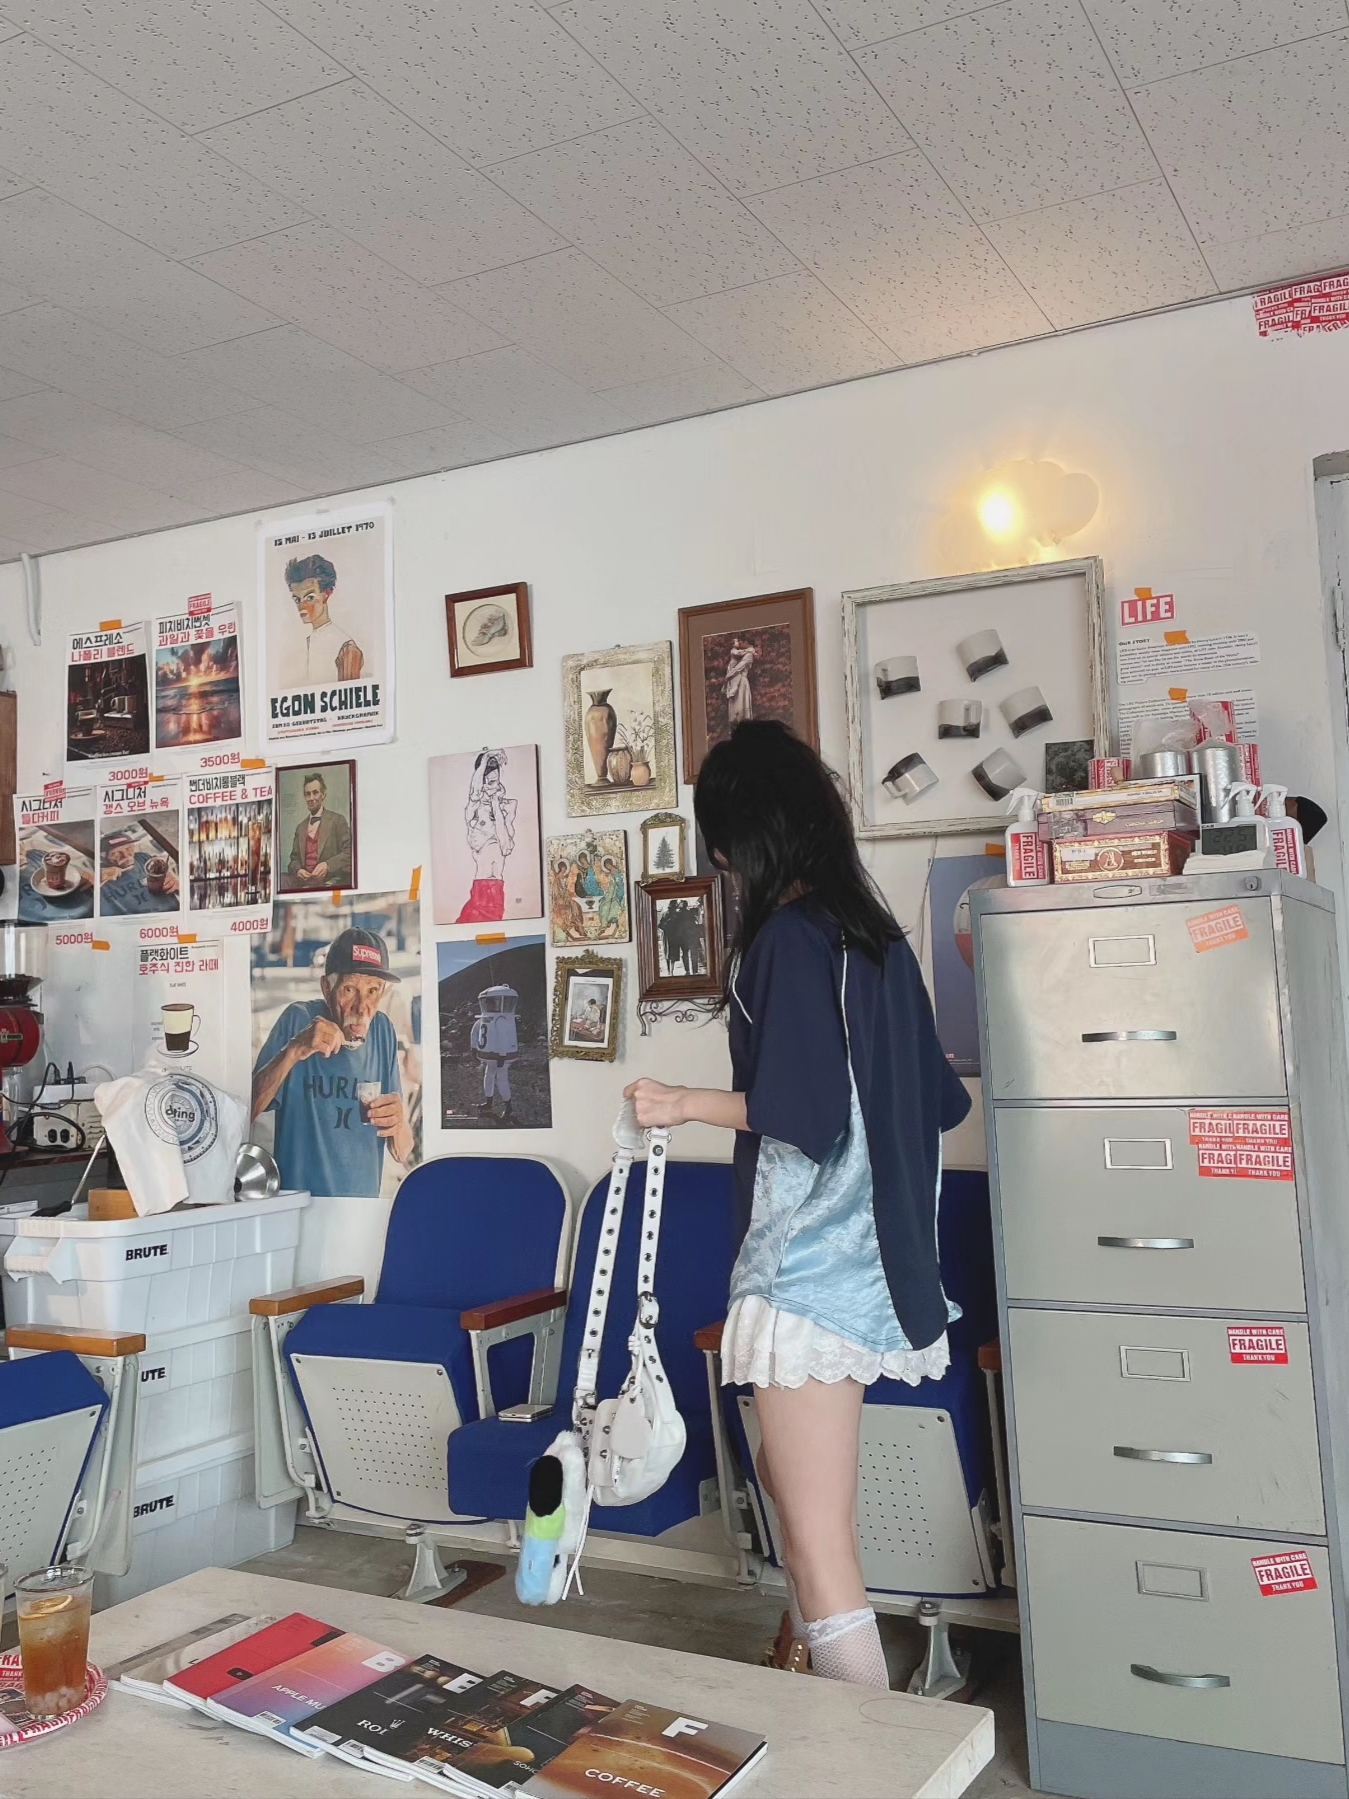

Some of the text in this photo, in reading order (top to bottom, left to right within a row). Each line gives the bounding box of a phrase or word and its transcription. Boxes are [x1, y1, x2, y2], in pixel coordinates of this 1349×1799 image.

[1313, 302, 1349, 314] FRAGIL
[285, 535, 300, 544] MAI
[319, 526, 352, 538] JUILLET
[356, 522, 374, 532] 1970
[1123, 597, 1172, 624] LIFE
[72, 632, 123, 650] 에스프레소
[158, 632, 190, 646] 과일과
[218, 621, 236, 636] 우린
[71, 648, 102, 662] 나폴리
[270, 684, 380, 718] EGON SCHIELE
[200, 752, 240, 768] 3500원
[108, 767, 148, 781] 3000원
[104, 786, 146, 802] 시그니처
[190, 786, 272, 804] COFFEE & TEA
[128, 800, 146, 812] 오브
[150, 797, 169, 810] 뉴욕
[1022, 834, 1035, 878] FRAGILE
[140, 926, 179, 939] 6000원
[230, 918, 268, 932] 4000원
[1192, 915, 1242, 941] FRAGILE
[56, 932, 94, 946] 5000원
[140, 946, 189, 962] 플랫화이트
[139, 958, 218, 976] 호주식 진한 라떼
[1235, 1122, 1286, 1136] FRAGILE
[1238, 1154, 1290, 1168] FRAGILE
[126, 1244, 168, 1261] BRUTE
[1231, 1338, 1284, 1351] FRAGILE
[140, 1367, 166, 1382] UTE
[134, 1495, 174, 1518] BRUTE
[1291, 1553, 1307, 1561] CARE
[1258, 1563, 1310, 1582] FRAGILE
[1272, 1583, 1291, 1591] THANK
[361, 1650, 406, 1672] B
[272, 1684, 327, 1710] APPLE MU
[662, 1716, 708, 1738] F
[427, 1727, 473, 1748] WHIS
[585, 1768, 666, 1798] COFFEE
